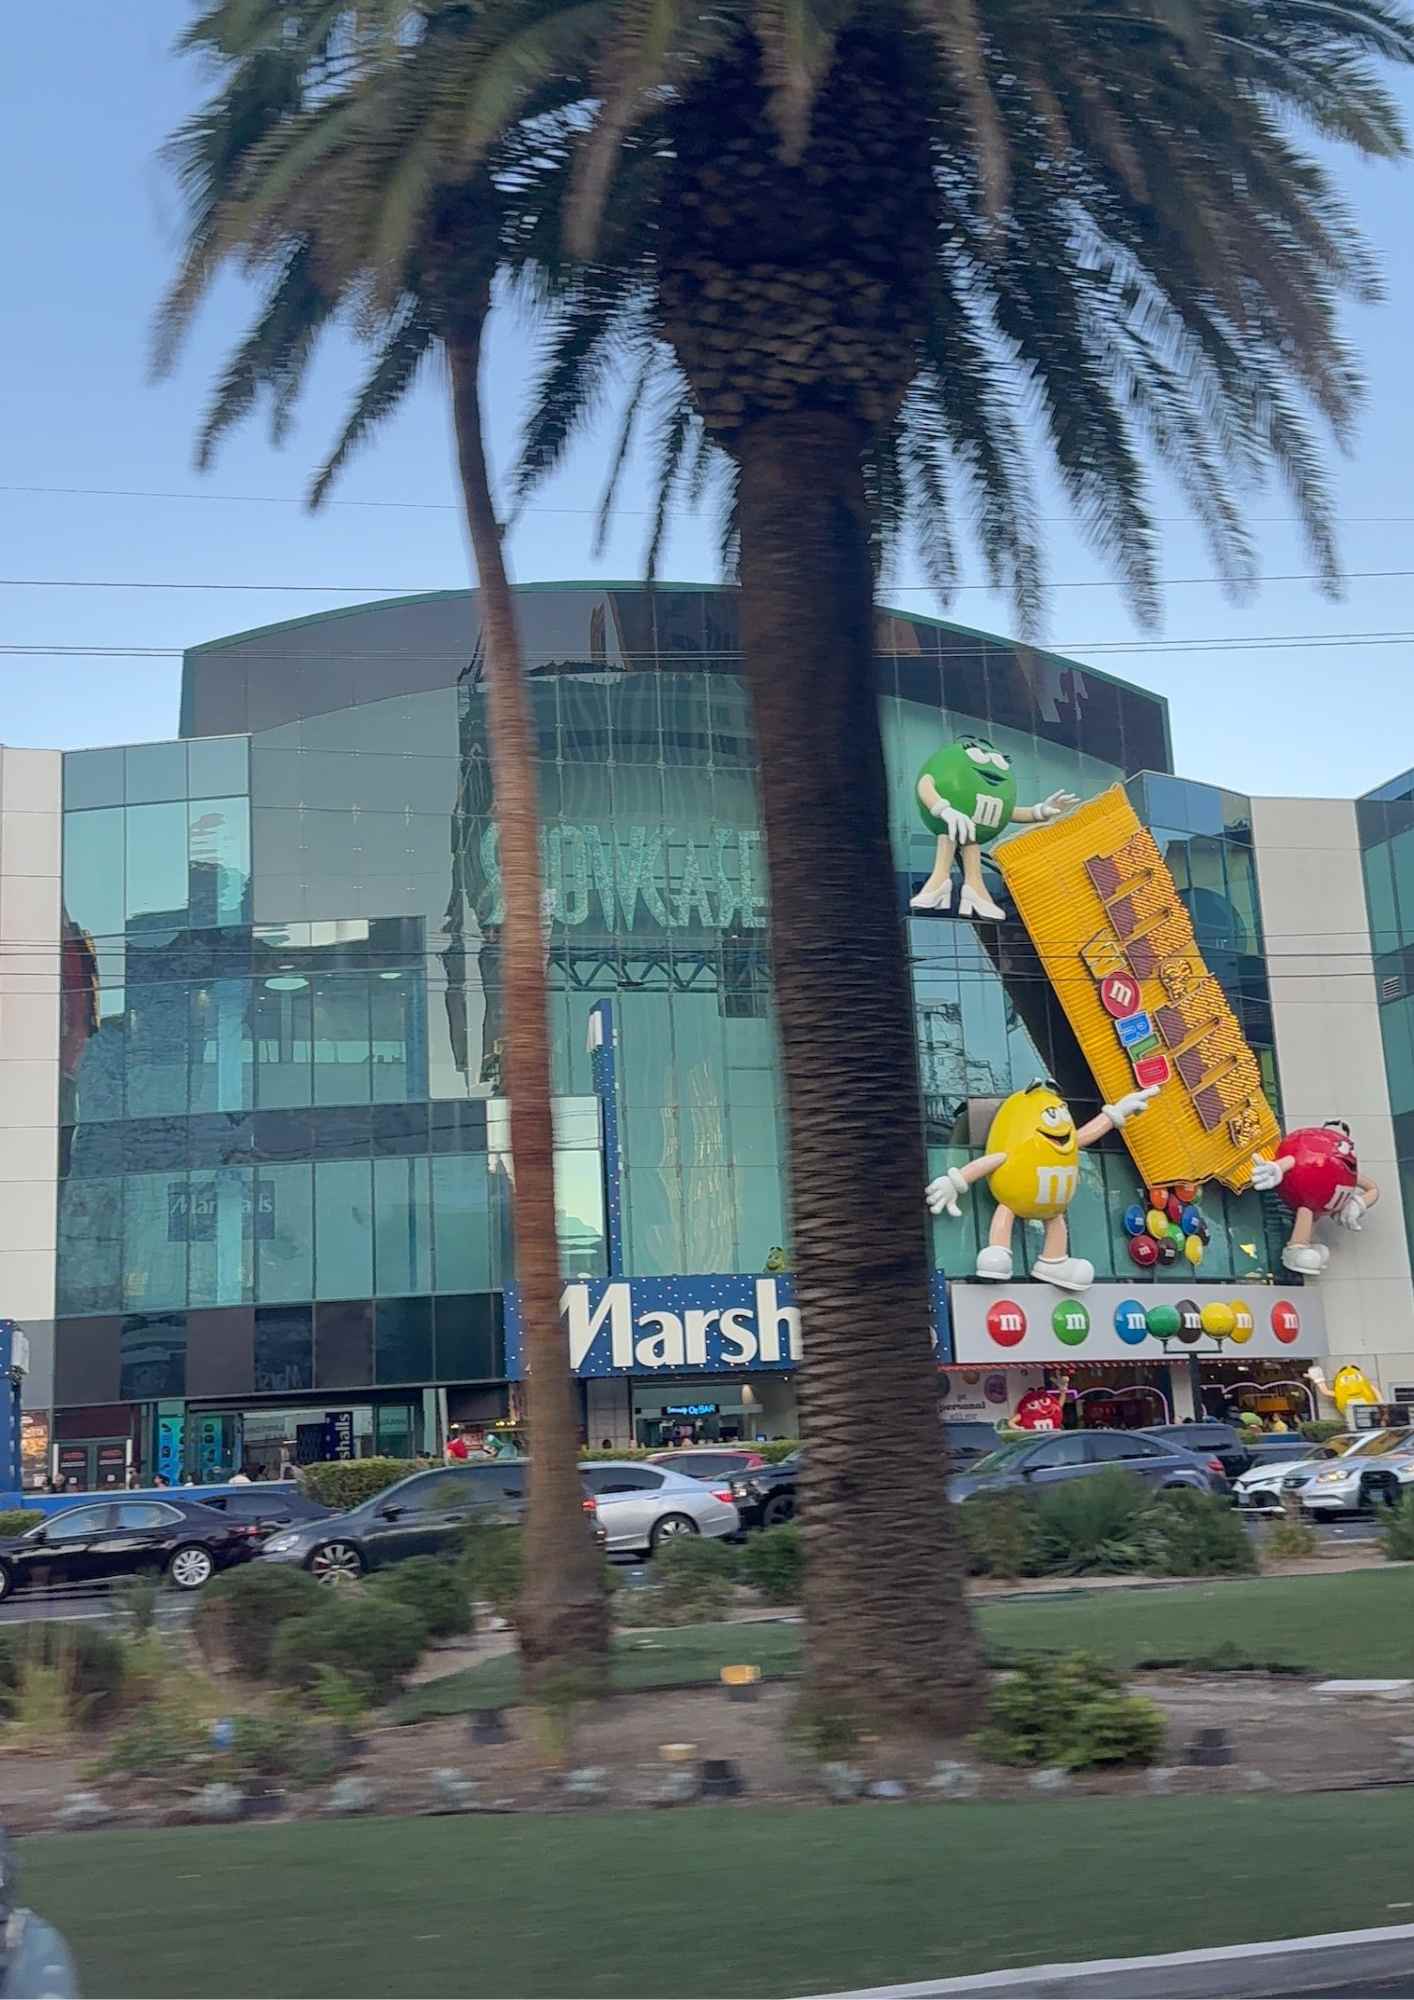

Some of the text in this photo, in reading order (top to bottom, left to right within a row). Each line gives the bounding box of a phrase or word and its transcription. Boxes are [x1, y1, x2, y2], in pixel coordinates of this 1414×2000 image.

[972, 793, 1004, 828] m
[1036, 1166, 1078, 1204] m
[1000, 1313, 1299, 1331] m m m m m m
